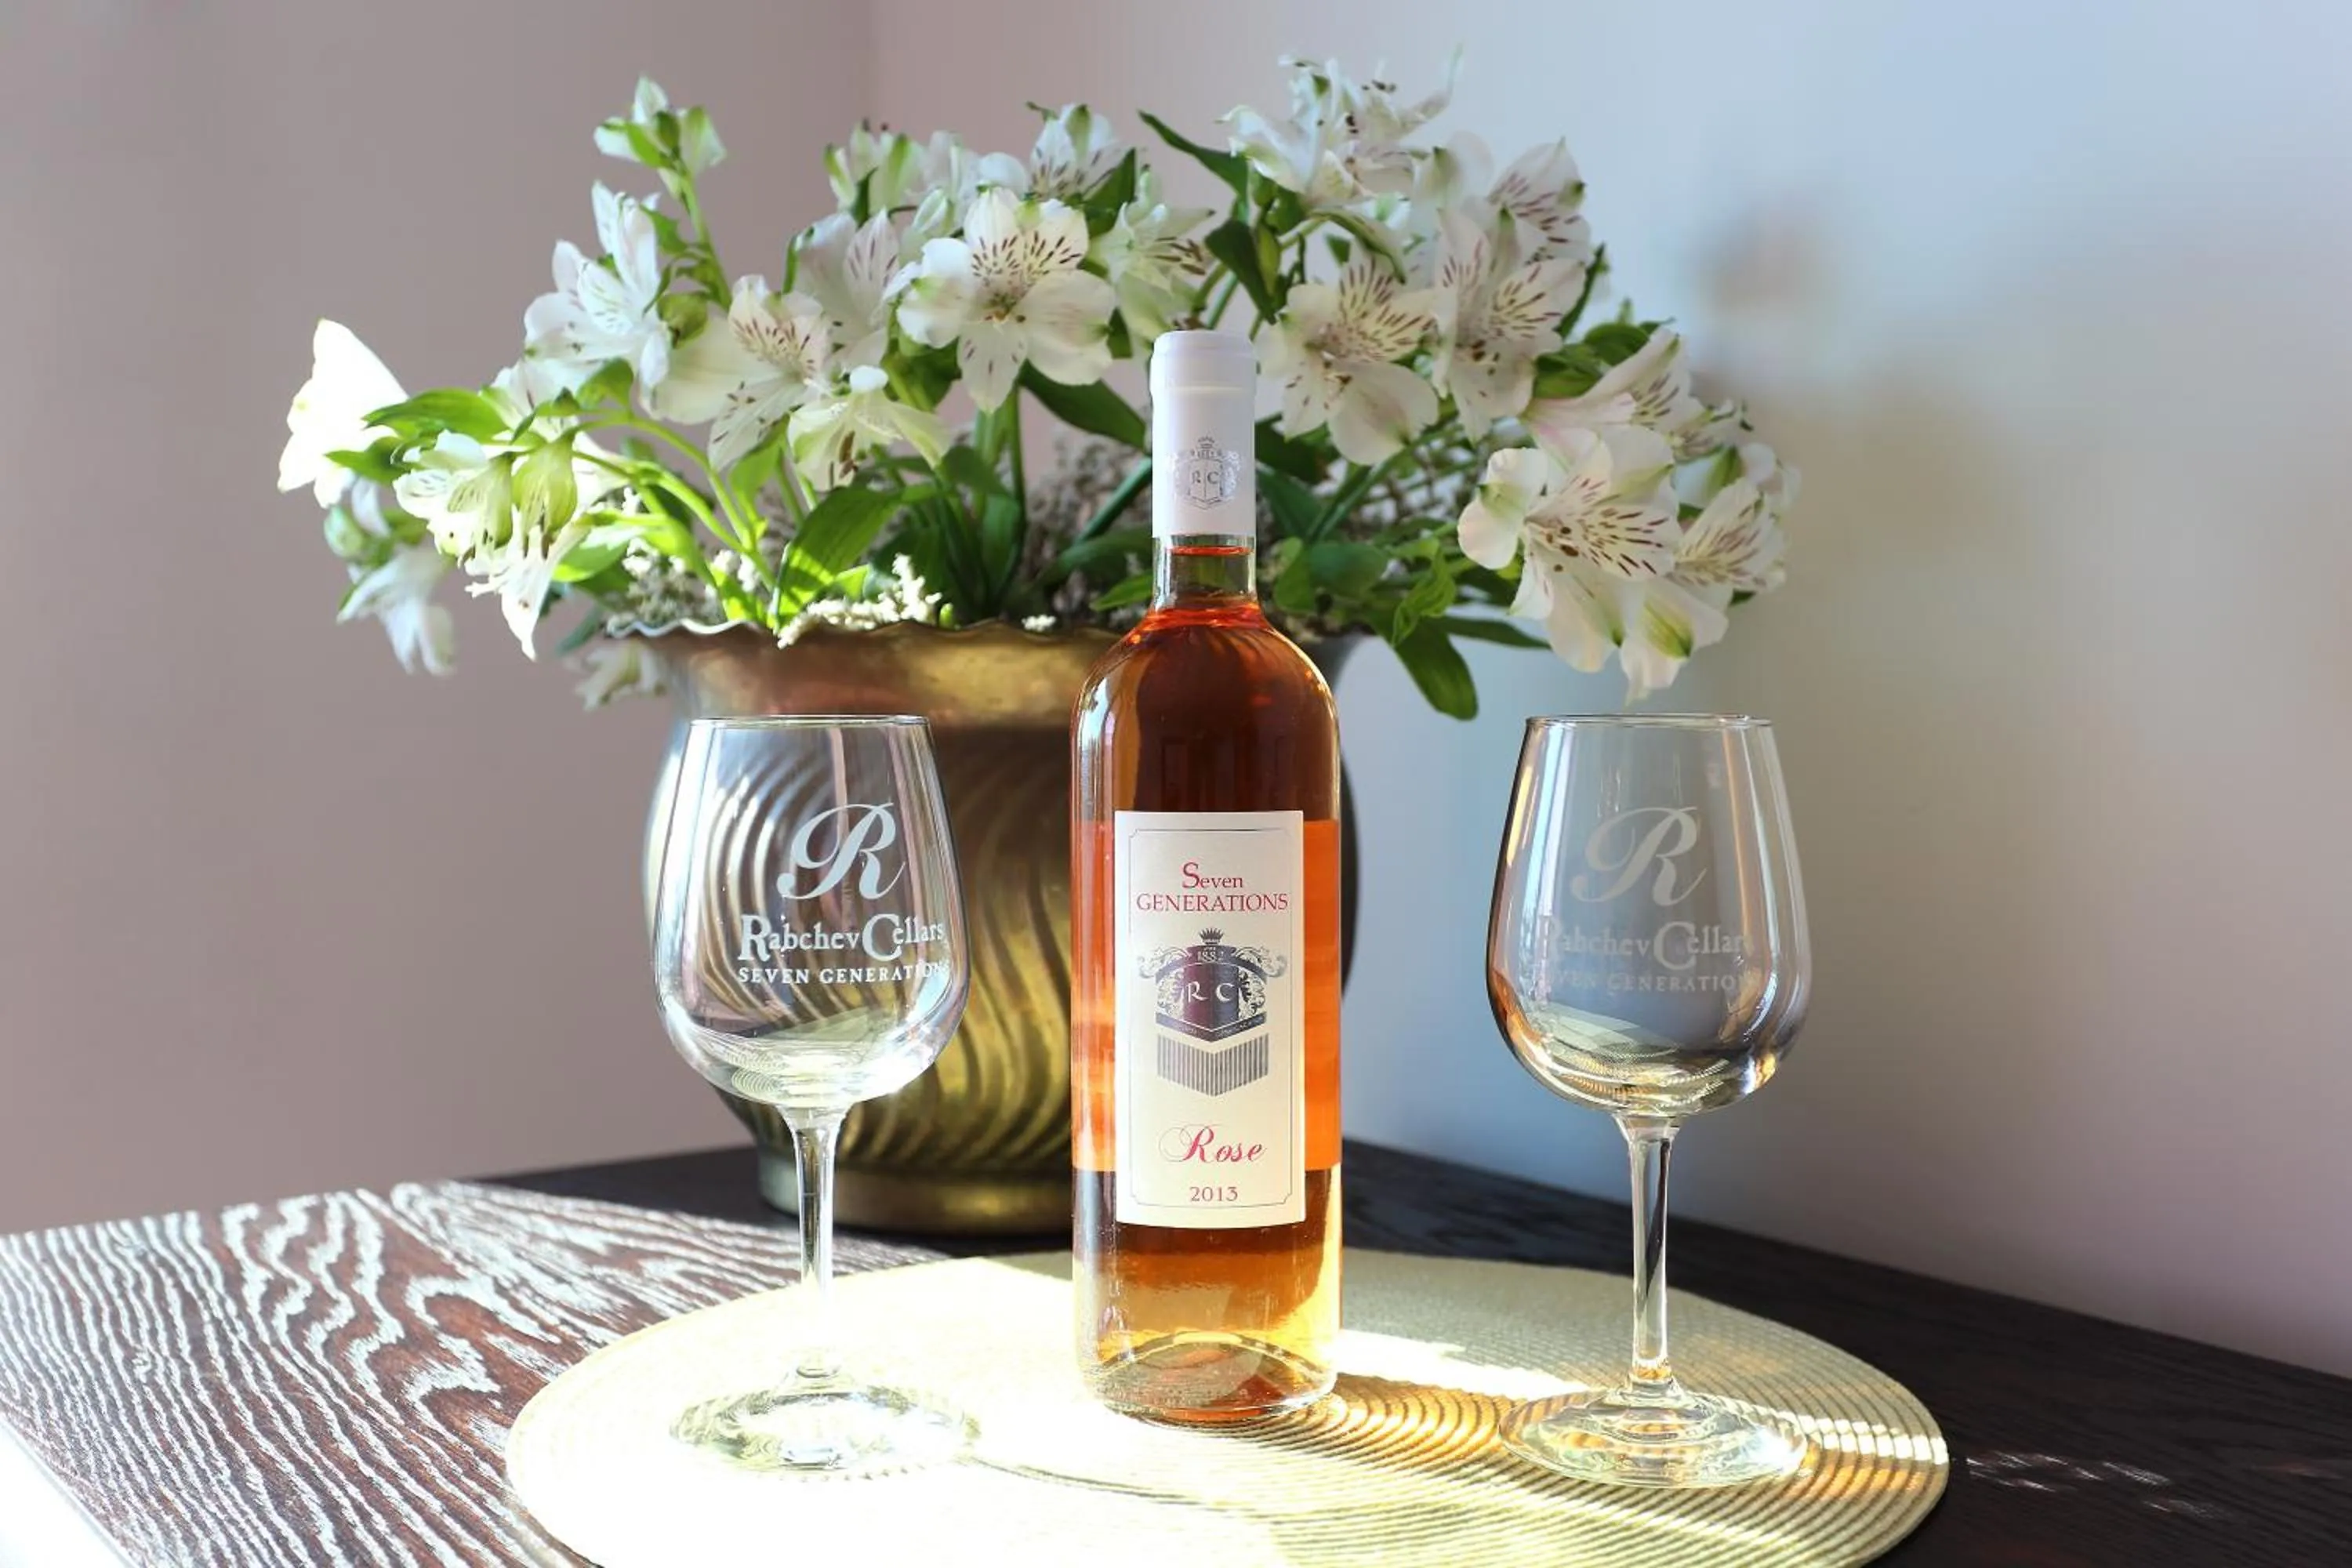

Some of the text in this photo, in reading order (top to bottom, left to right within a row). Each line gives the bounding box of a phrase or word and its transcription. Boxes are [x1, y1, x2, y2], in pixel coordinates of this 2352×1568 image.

[1207, 471, 1219, 485] C
[777, 804, 906, 899] R
[1570, 806, 1708, 906] R
[1181, 862, 1243, 889] Seven
[1136, 892, 1289, 913] GENERATIONS
[737, 913, 944, 961] Rabchev Cellars
[1653, 920, 1751, 971] Cellar
[738, 967, 810, 985] SEVEN
[1607, 972, 1755, 993] GENERATIO
[1186, 981, 1234, 1003] R C
[1158, 1123, 1268, 1163] Rose
[1189, 1186, 1239, 1202] 2013
